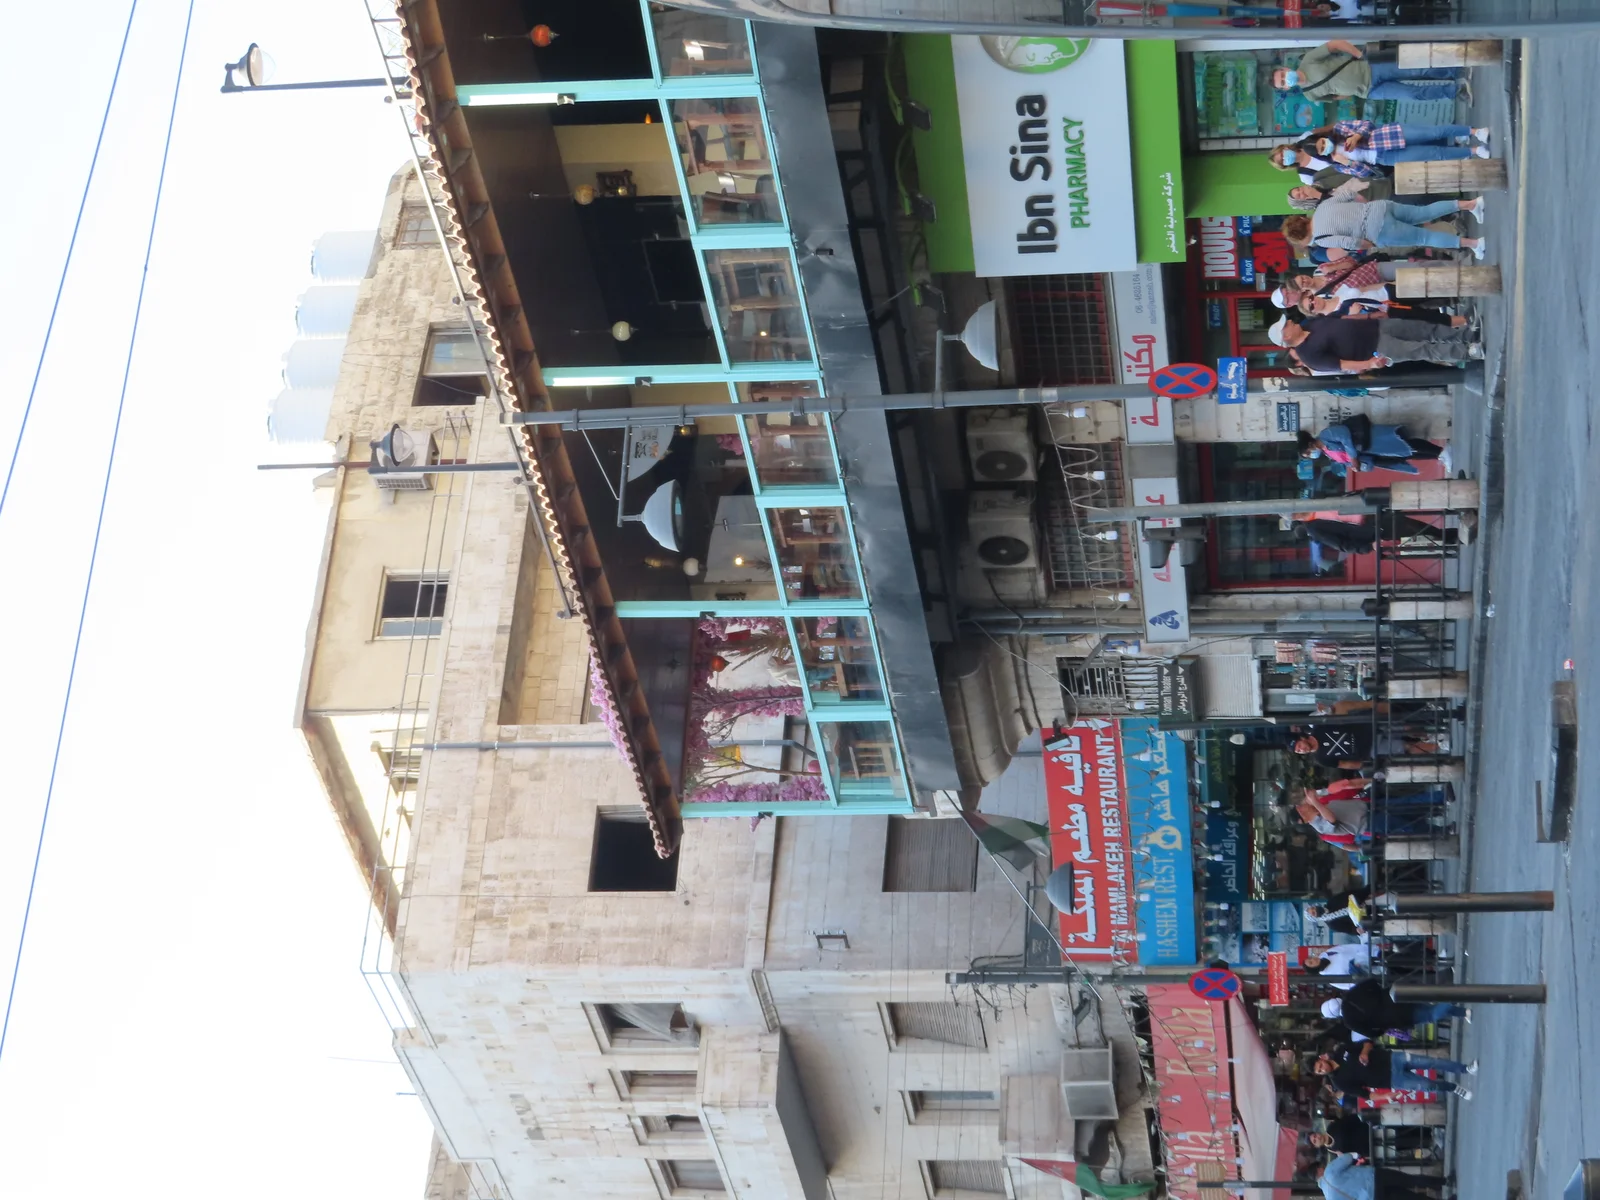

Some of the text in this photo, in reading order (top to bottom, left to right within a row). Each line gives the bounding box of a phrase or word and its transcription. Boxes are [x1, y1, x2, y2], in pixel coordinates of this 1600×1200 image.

[1008, 94, 1058, 254] Ibn Sina
[1062, 117, 1090, 229] PHARMACY
[1159, 172, 1174, 197] شركة
[1163, 198, 1178, 229] صيدلية
[1245, 259, 1253, 276] PILOT
[1251, 231, 1290, 273] 3M
[1160, 675, 1172, 696] Theater
[1095, 734, 1122, 837] RESTAURANT
[1060, 803, 1101, 864] مطعم
[1103, 842, 1129, 925] MAMLAKEH
[1221, 859, 1240, 894] الحاضر
[1153, 851, 1179, 957] HASHEM REST.
